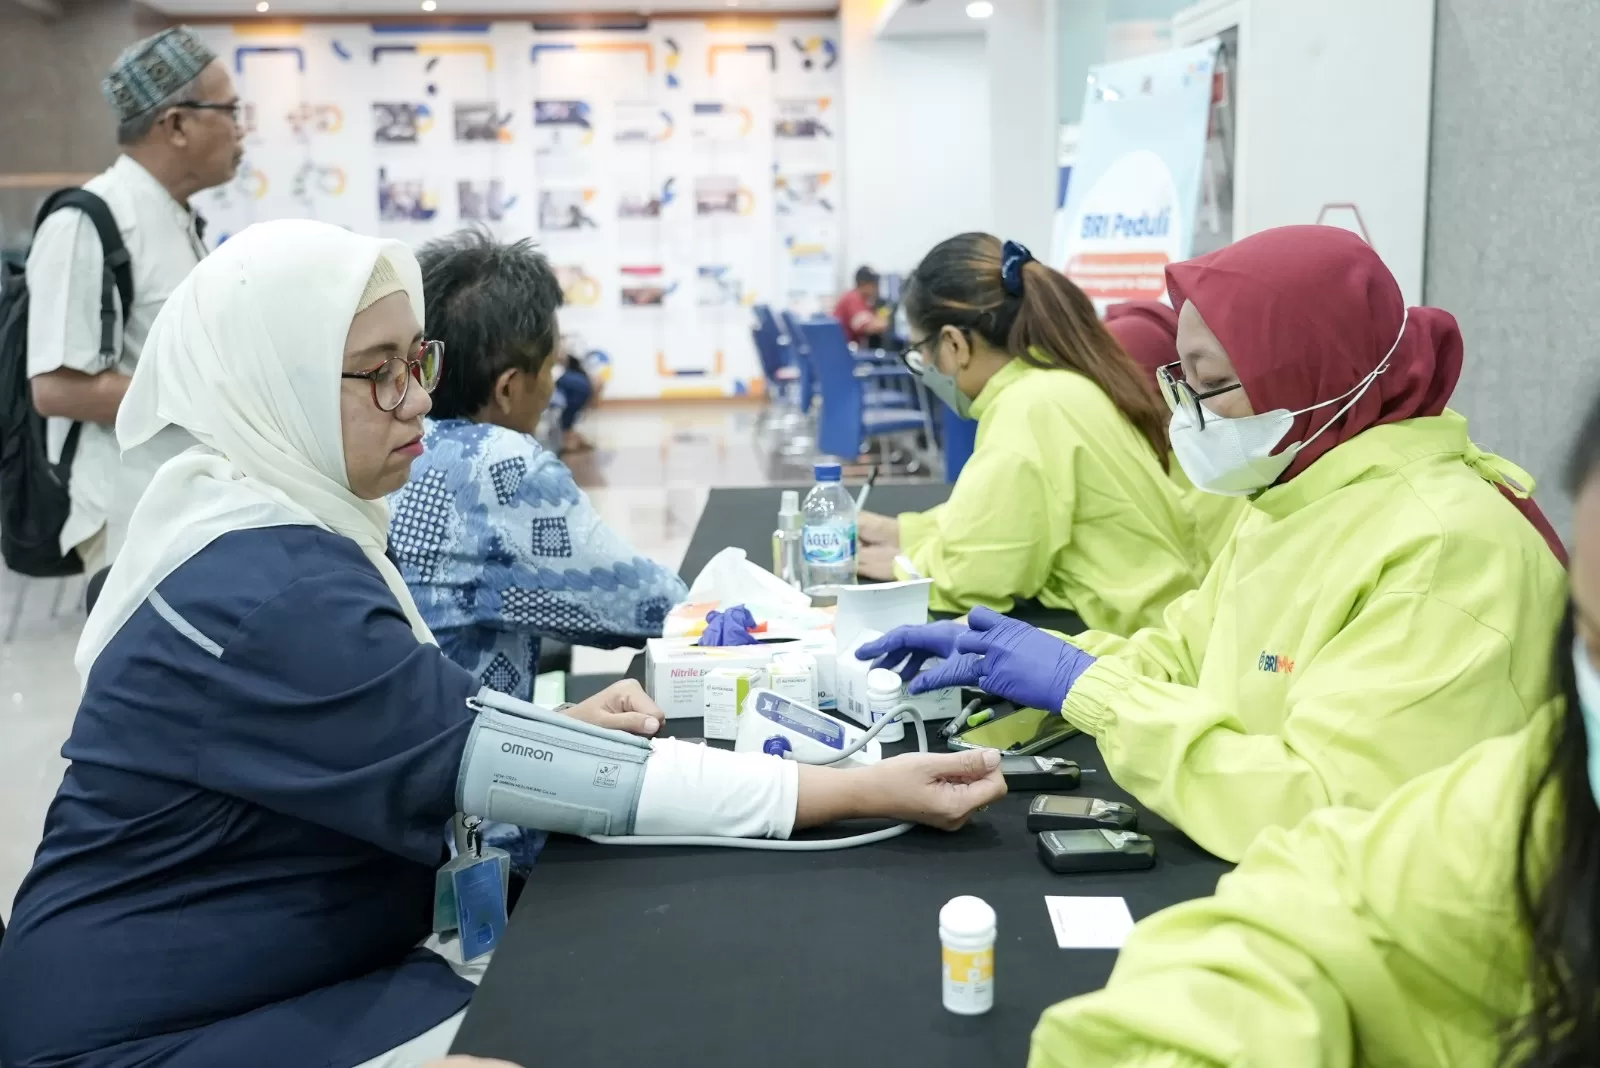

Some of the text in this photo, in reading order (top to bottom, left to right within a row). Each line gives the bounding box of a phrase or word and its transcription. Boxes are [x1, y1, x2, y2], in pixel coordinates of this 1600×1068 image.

[1081, 205, 1171, 239] BRI Peduli
[806, 533, 839, 546] AQUA
[670, 667, 698, 678] Nitrile
[501, 742, 553, 762] OMRON
